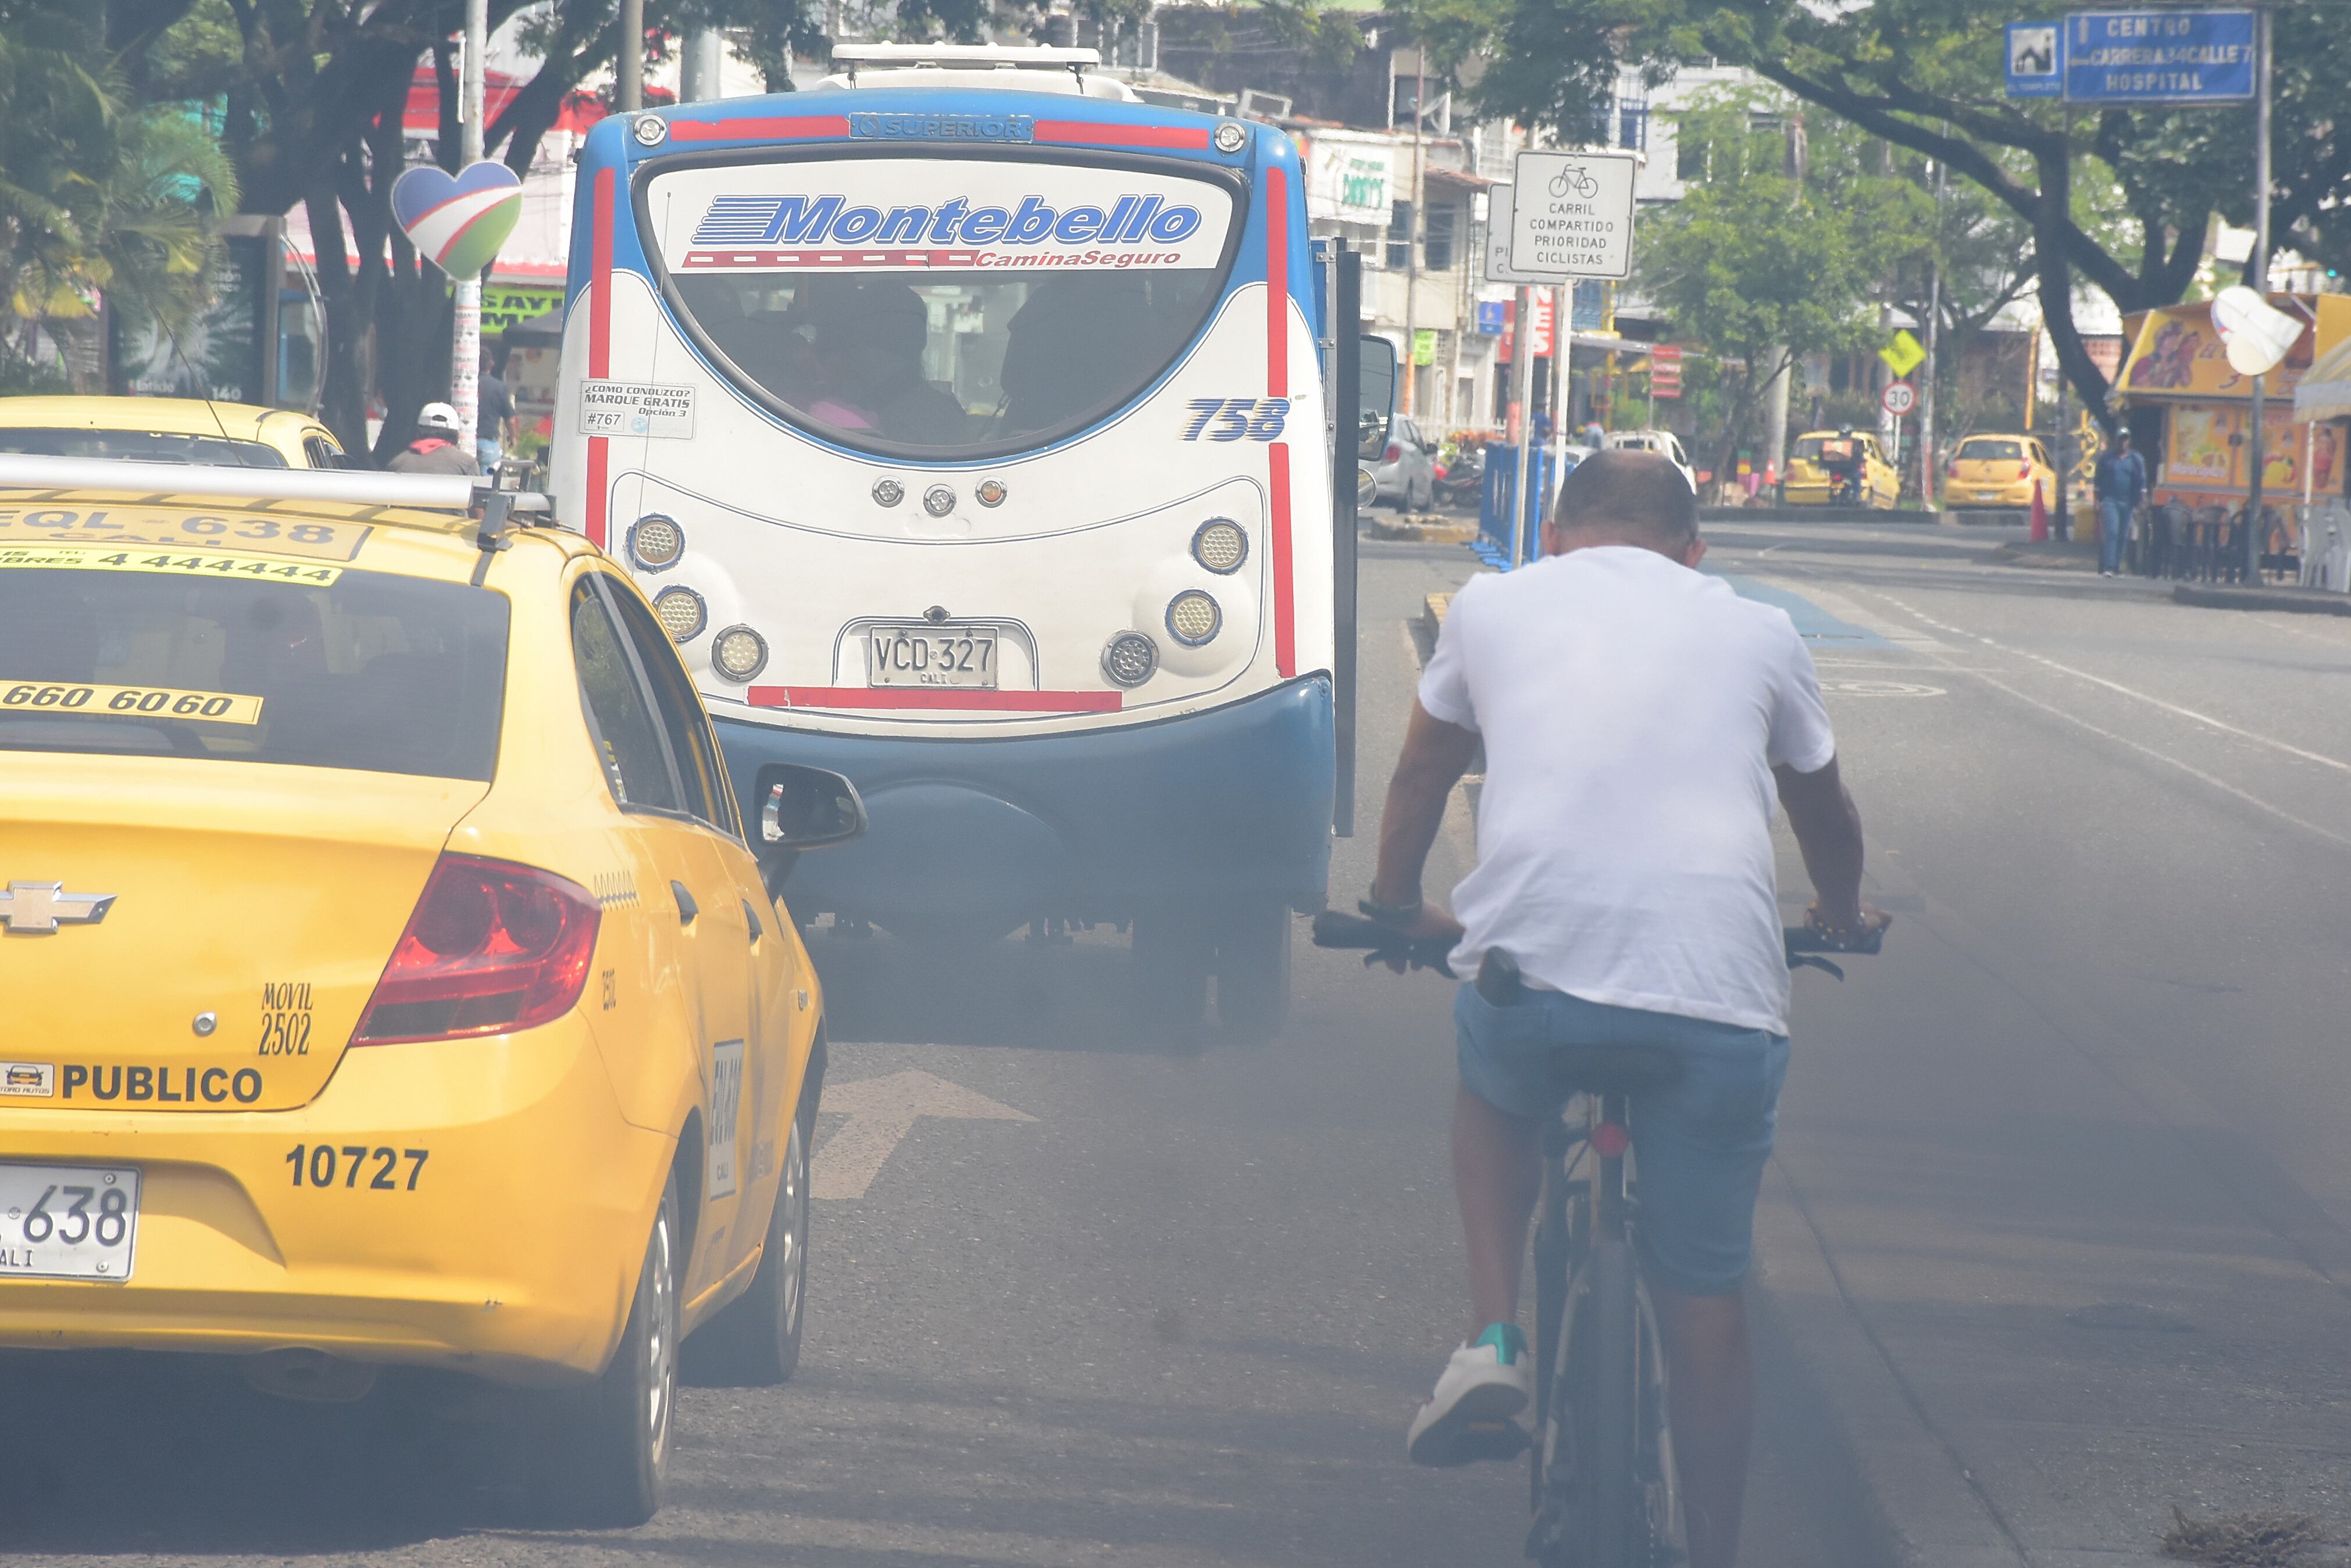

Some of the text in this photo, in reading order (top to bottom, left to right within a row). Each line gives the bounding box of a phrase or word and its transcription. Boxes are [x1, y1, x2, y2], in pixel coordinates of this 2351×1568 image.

[2107, 17, 2191, 37] CENTRO
[2090, 47, 2163, 66] CARRERA
[2187, 44, 2239, 64] CALLE
[2106, 73, 2203, 91] HOSPITAL
[884, 119, 1022, 137] SUPERIOR
[1549, 203, 1595, 216] CARRIL
[759, 194, 1202, 245] Montebello
[1530, 219, 1614, 233] COMPARTIDO
[1535, 235, 1607, 249] PRIORIDAD
[975, 251, 1181, 268] CaminaSeguro
[1537, 252, 1603, 265] CICLISTAS
[585, 385, 690, 397] ¿COMO CONDUZCO?
[1889, 390, 1910, 407] 30
[584, 394, 690, 408] MARQUE GRATIS
[587, 413, 622, 426] #767
[638, 408, 676, 417] Opción
[1178, 398, 1290, 442] 758
[0, 510, 336, 545] EQL 638
[49, 533, 222, 546] CALI
[97, 553, 129, 566] 4
[875, 637, 994, 672] VCD 327
[920, 672, 947, 684] CALI
[3, 684, 94, 708] 660
[261, 983, 313, 1010] MOVIL
[259, 1013, 312, 1055] 2502
[62, 1065, 263, 1103] PUBLICO
[285, 1144, 429, 1191] 10727
[23, 1185, 127, 1248] 638
[0, 1248, 33, 1267] ALI
